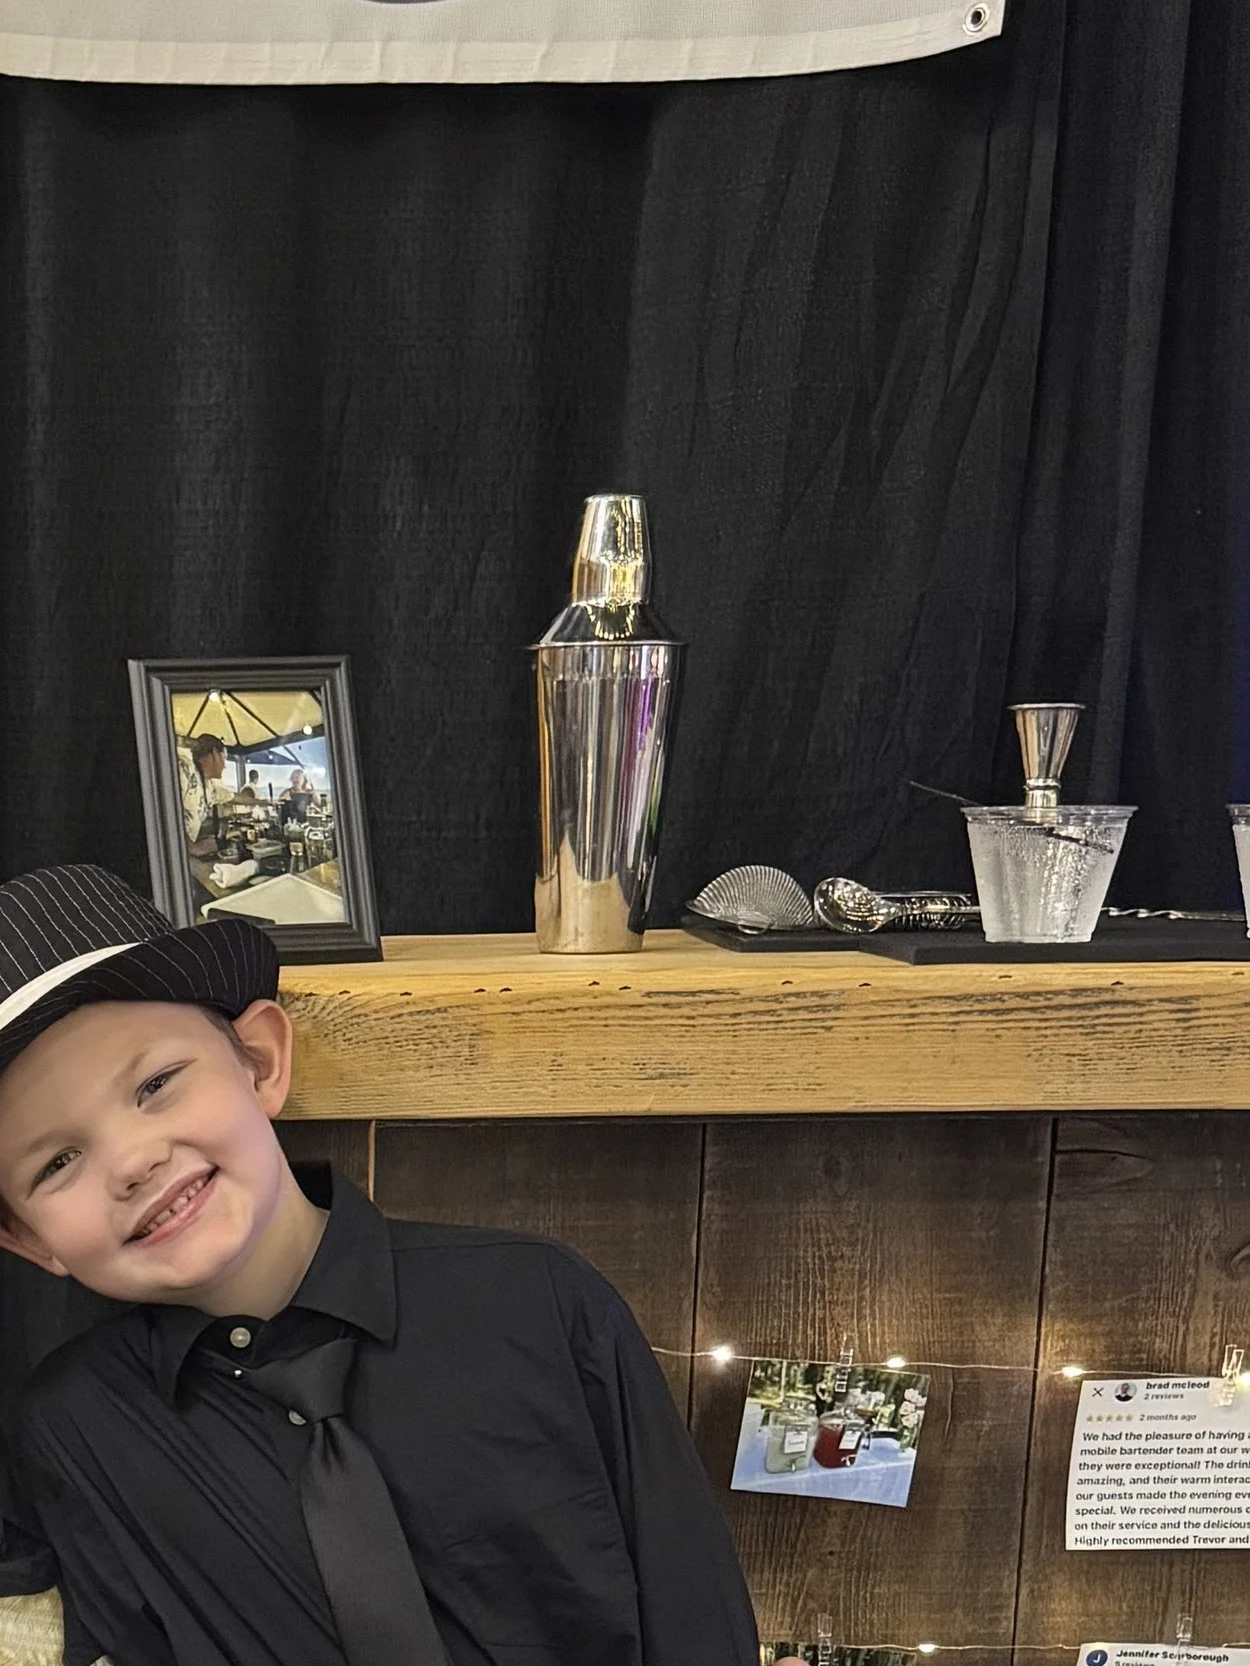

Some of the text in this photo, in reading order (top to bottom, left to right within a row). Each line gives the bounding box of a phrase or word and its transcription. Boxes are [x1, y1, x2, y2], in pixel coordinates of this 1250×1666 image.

[1146, 1382, 1170, 1390] brad
[1083, 1433, 1099, 1441] We
[1102, 1432, 1122, 1440] had
[1125, 1432, 1142, 1440] the
[1145, 1432, 1192, 1442] pleasure
[1195, 1431, 1206, 1439] of
[1209, 1431, 1244, 1441] having
[1080, 1447, 1116, 1455] mobile
[1120, 1447, 1174, 1455] bartender
[1079, 1462, 1103, 1472] they
[1135, 1461, 1200, 1472] exceptional!
[1205, 1461, 1224, 1469] The
[1077, 1477, 1126, 1486] amazing,
[1129, 1476, 1150, 1484] and
[1153, 1476, 1176, 1484] their
[1097, 1492, 1133, 1502] guests
[1136, 1491, 1167, 1499] made
[1170, 1491, 1187, 1499] the
[1189, 1491, 1232, 1501] evening
[1075, 1506, 1116, 1516] special.
[1120, 1506, 1137, 1514] We
[1139, 1506, 1186, 1514] received
[1091, 1521, 1116, 1530] their
[1118, 1521, 1158, 1529] service
[1160, 1521, 1181, 1529] and
[1183, 1521, 1201, 1529] the
[1075, 1535, 1249, 1546] Highly recommended Trevor and
[1116, 1650, 1159, 1659] Jennifer
